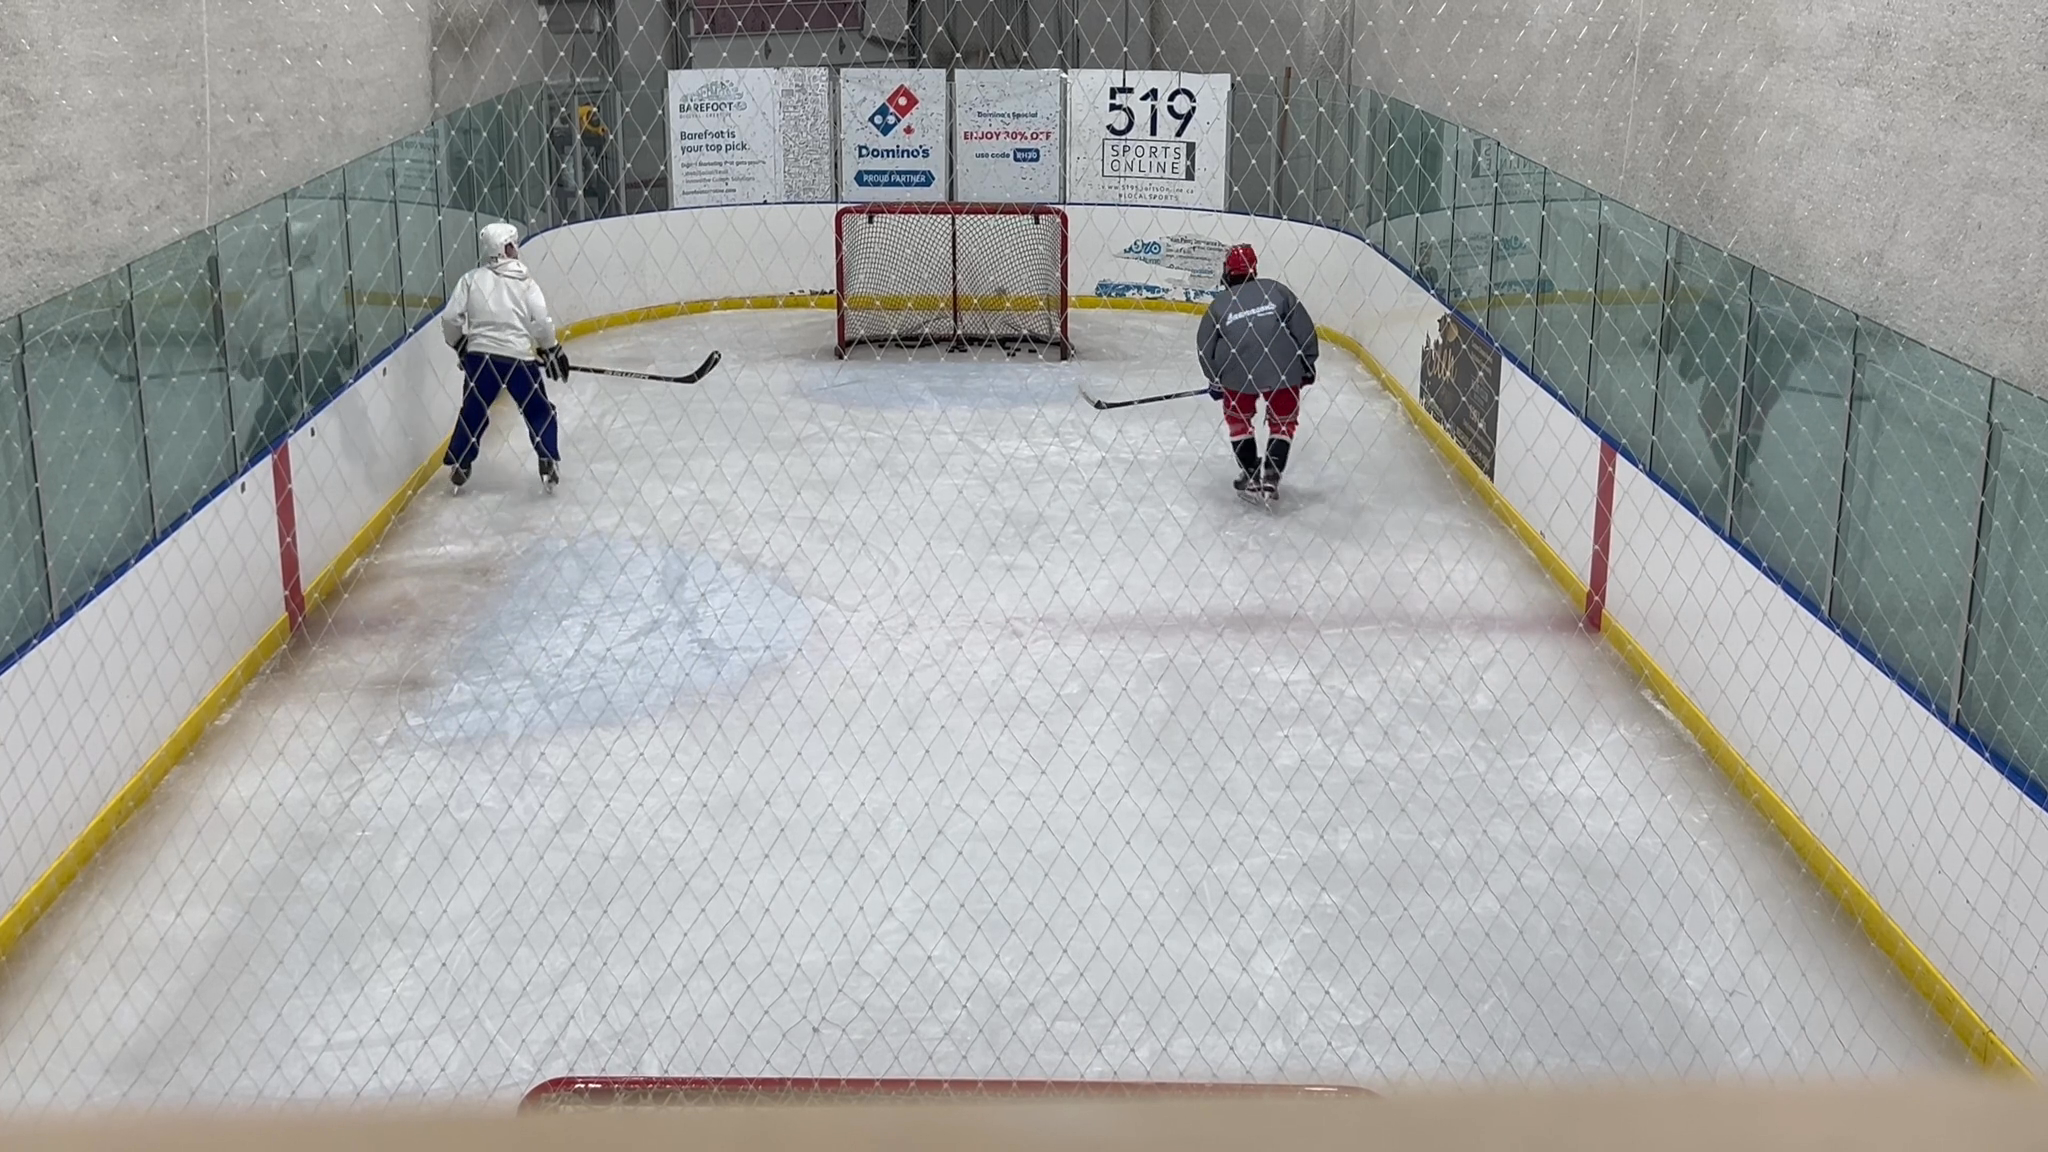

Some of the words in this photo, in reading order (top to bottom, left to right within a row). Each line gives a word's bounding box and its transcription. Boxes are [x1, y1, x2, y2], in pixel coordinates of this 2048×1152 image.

[679, 102, 734, 113] BAREFOOT
[1106, 87, 1197, 138] 519
[977, 111, 1011, 119] Domino's
[680, 129, 727, 141] Barefoot
[726, 129, 736, 140] is
[963, 131, 1001, 141] ENJOY
[1030, 131, 1053, 141] OFF
[680, 142, 704, 155] your
[706, 141, 723, 154] top
[725, 140, 751, 154] pick.
[857, 144, 931, 159] Domino's
[1110, 144, 1182, 160] SPORTS
[990, 151, 1011, 159] code
[1110, 159, 1181, 174] ONLINE
[863, 174, 889, 182] PROUD
[891, 173, 926, 182] PARTNER
